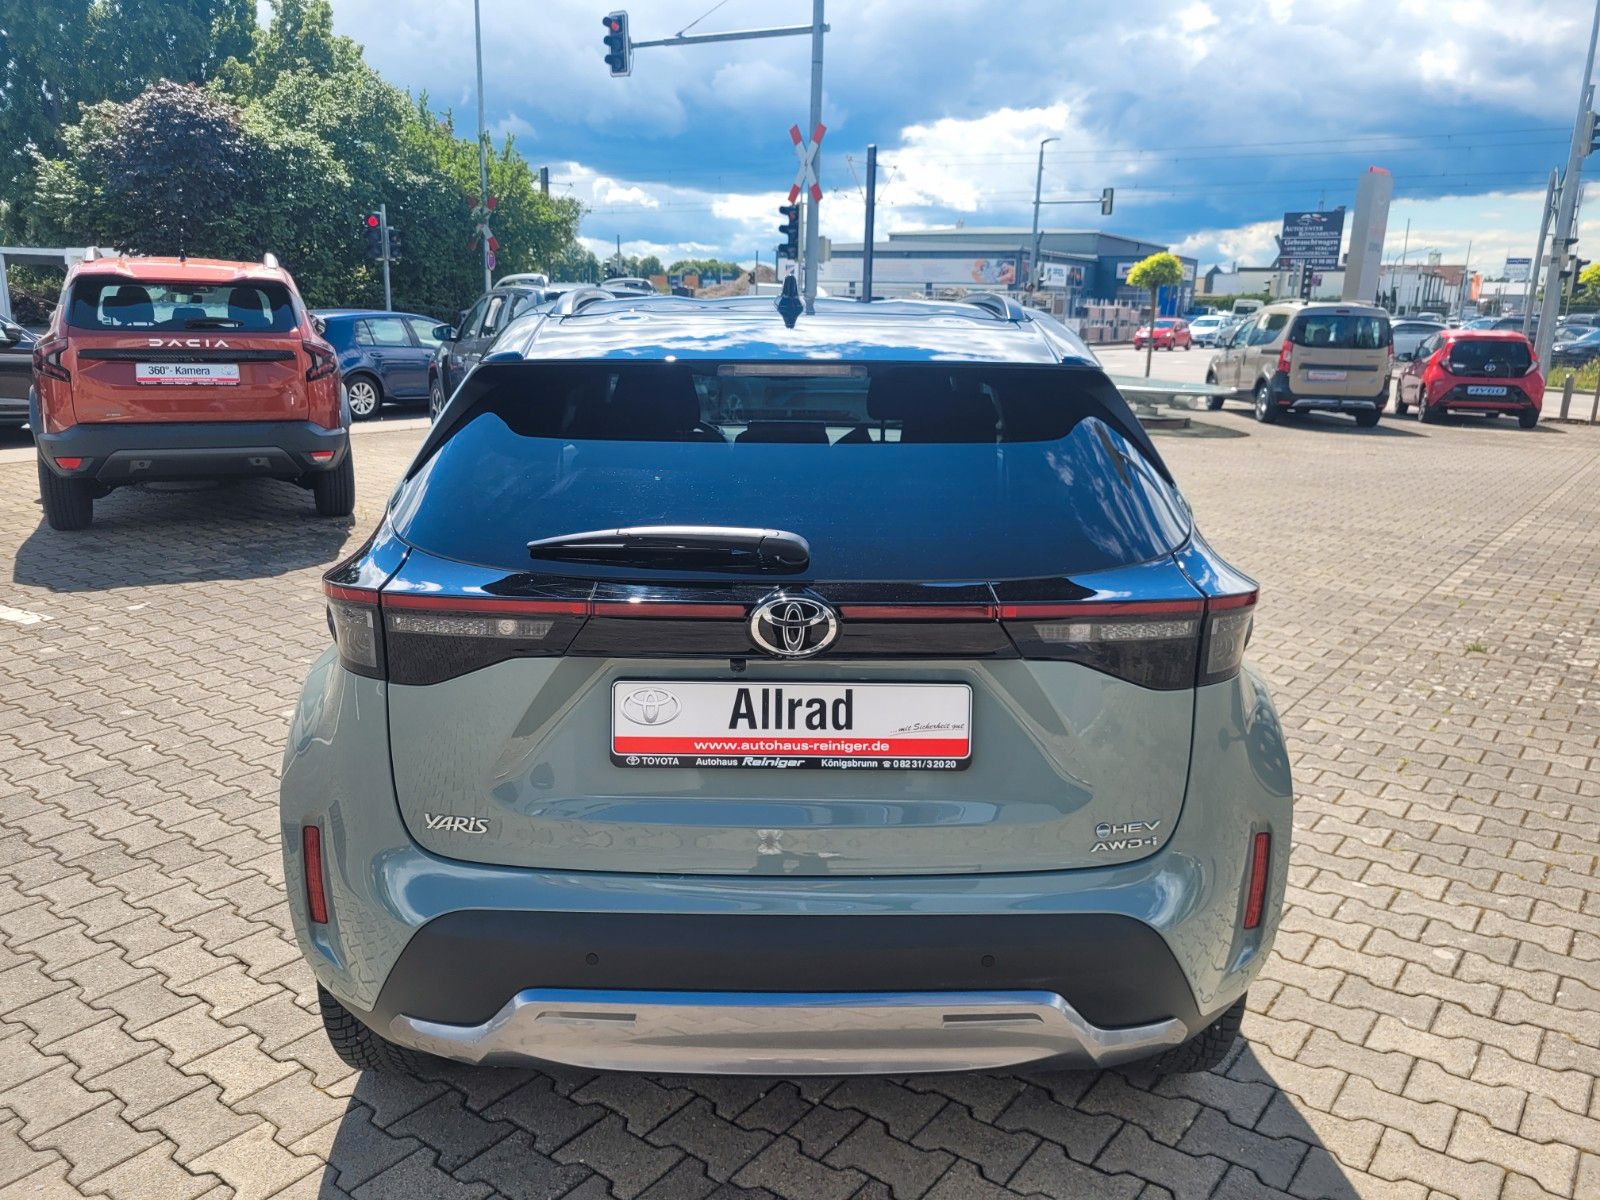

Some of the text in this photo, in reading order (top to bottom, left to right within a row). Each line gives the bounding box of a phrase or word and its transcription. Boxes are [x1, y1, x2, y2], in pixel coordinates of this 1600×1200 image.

[148, 338, 230, 348] DACIA
[175, 366, 211, 375] Kamera
[728, 687, 853, 731] Allrad
[912, 722, 951, 732] Sicherheit
[693, 738, 891, 754] www.autohaus-reiniger.de
[641, 756, 680, 766] TOYOTA
[695, 757, 738, 767] Autohaus
[741, 756, 805, 769] Reiniger
[821, 758, 878, 770] Königsbrunn
[1113, 820, 1160, 834] HEV
